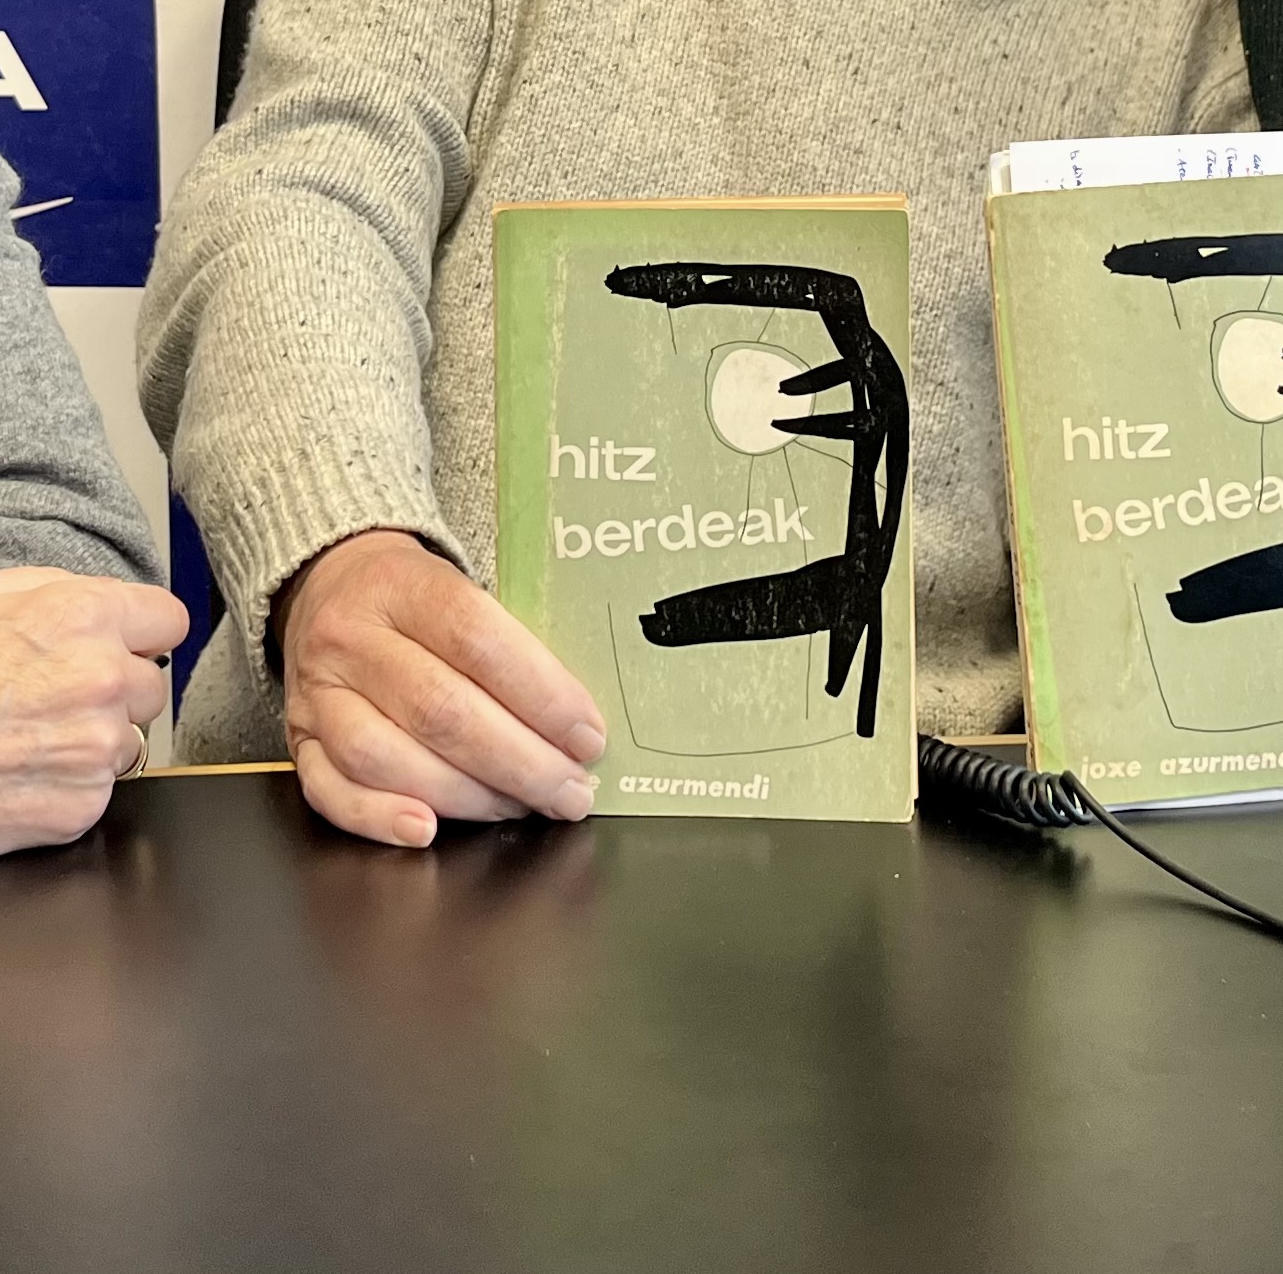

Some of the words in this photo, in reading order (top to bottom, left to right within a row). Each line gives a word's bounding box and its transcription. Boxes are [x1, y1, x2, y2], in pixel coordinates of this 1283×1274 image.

[549, 434, 657, 481] hitz
[1062, 416, 1171, 461] hitz
[553, 498, 815, 559] berdeak
[619, 774, 771, 800] azurmendi
[1079, 755, 1142, 787] joxe
